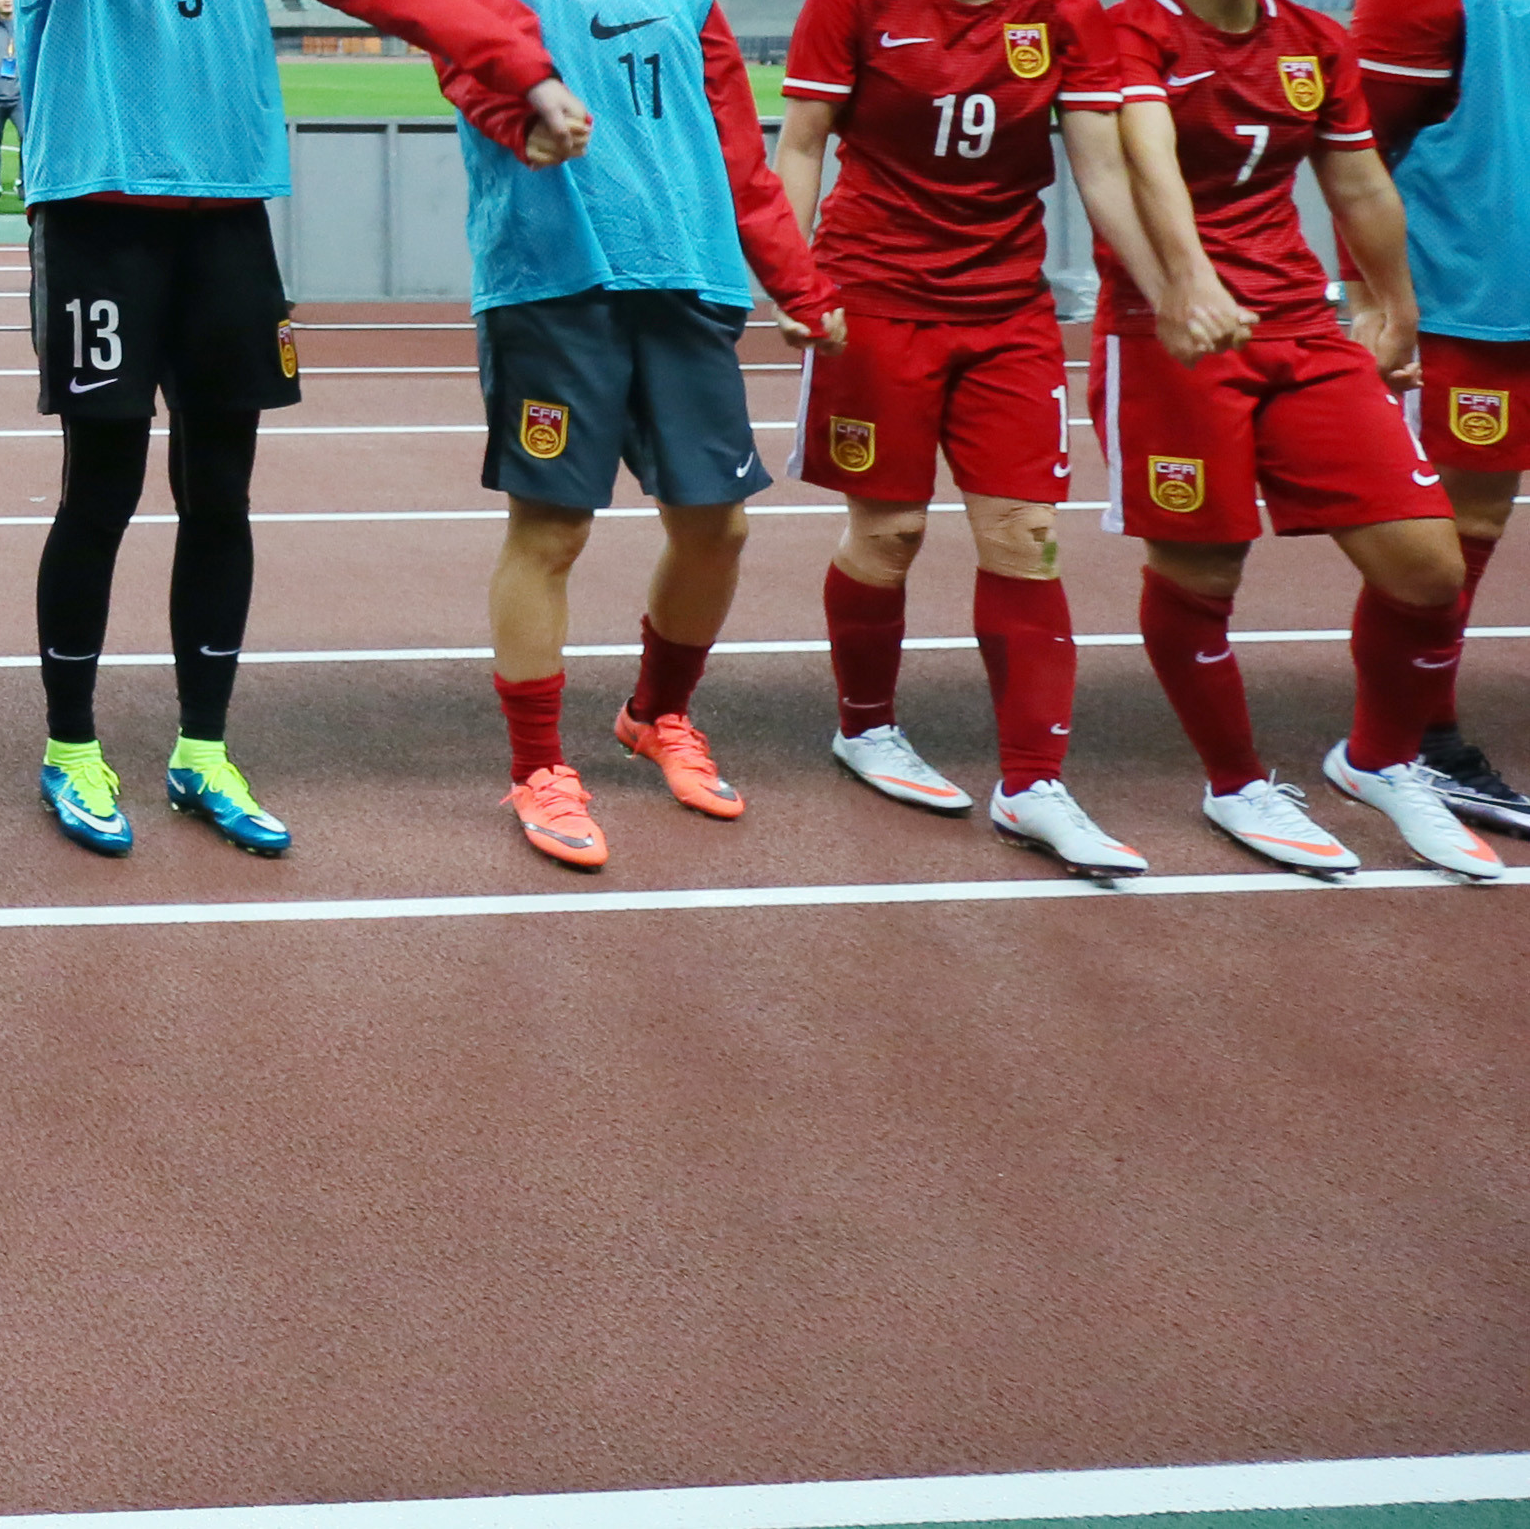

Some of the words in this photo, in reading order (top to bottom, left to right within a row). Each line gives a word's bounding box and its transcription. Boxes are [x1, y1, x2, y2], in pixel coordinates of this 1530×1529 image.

[1008, 29, 1040, 40] CFA
[618, 53, 662, 119] 11
[932, 93, 996, 159] 19
[1235, 125, 1270, 186] 7
[66, 298, 123, 370] 13
[529, 406, 562, 420] CFA
[1051, 385, 1068, 453] 1
[1458, 394, 1500, 406] CFA
[1156, 462, 1196, 475] CFA
